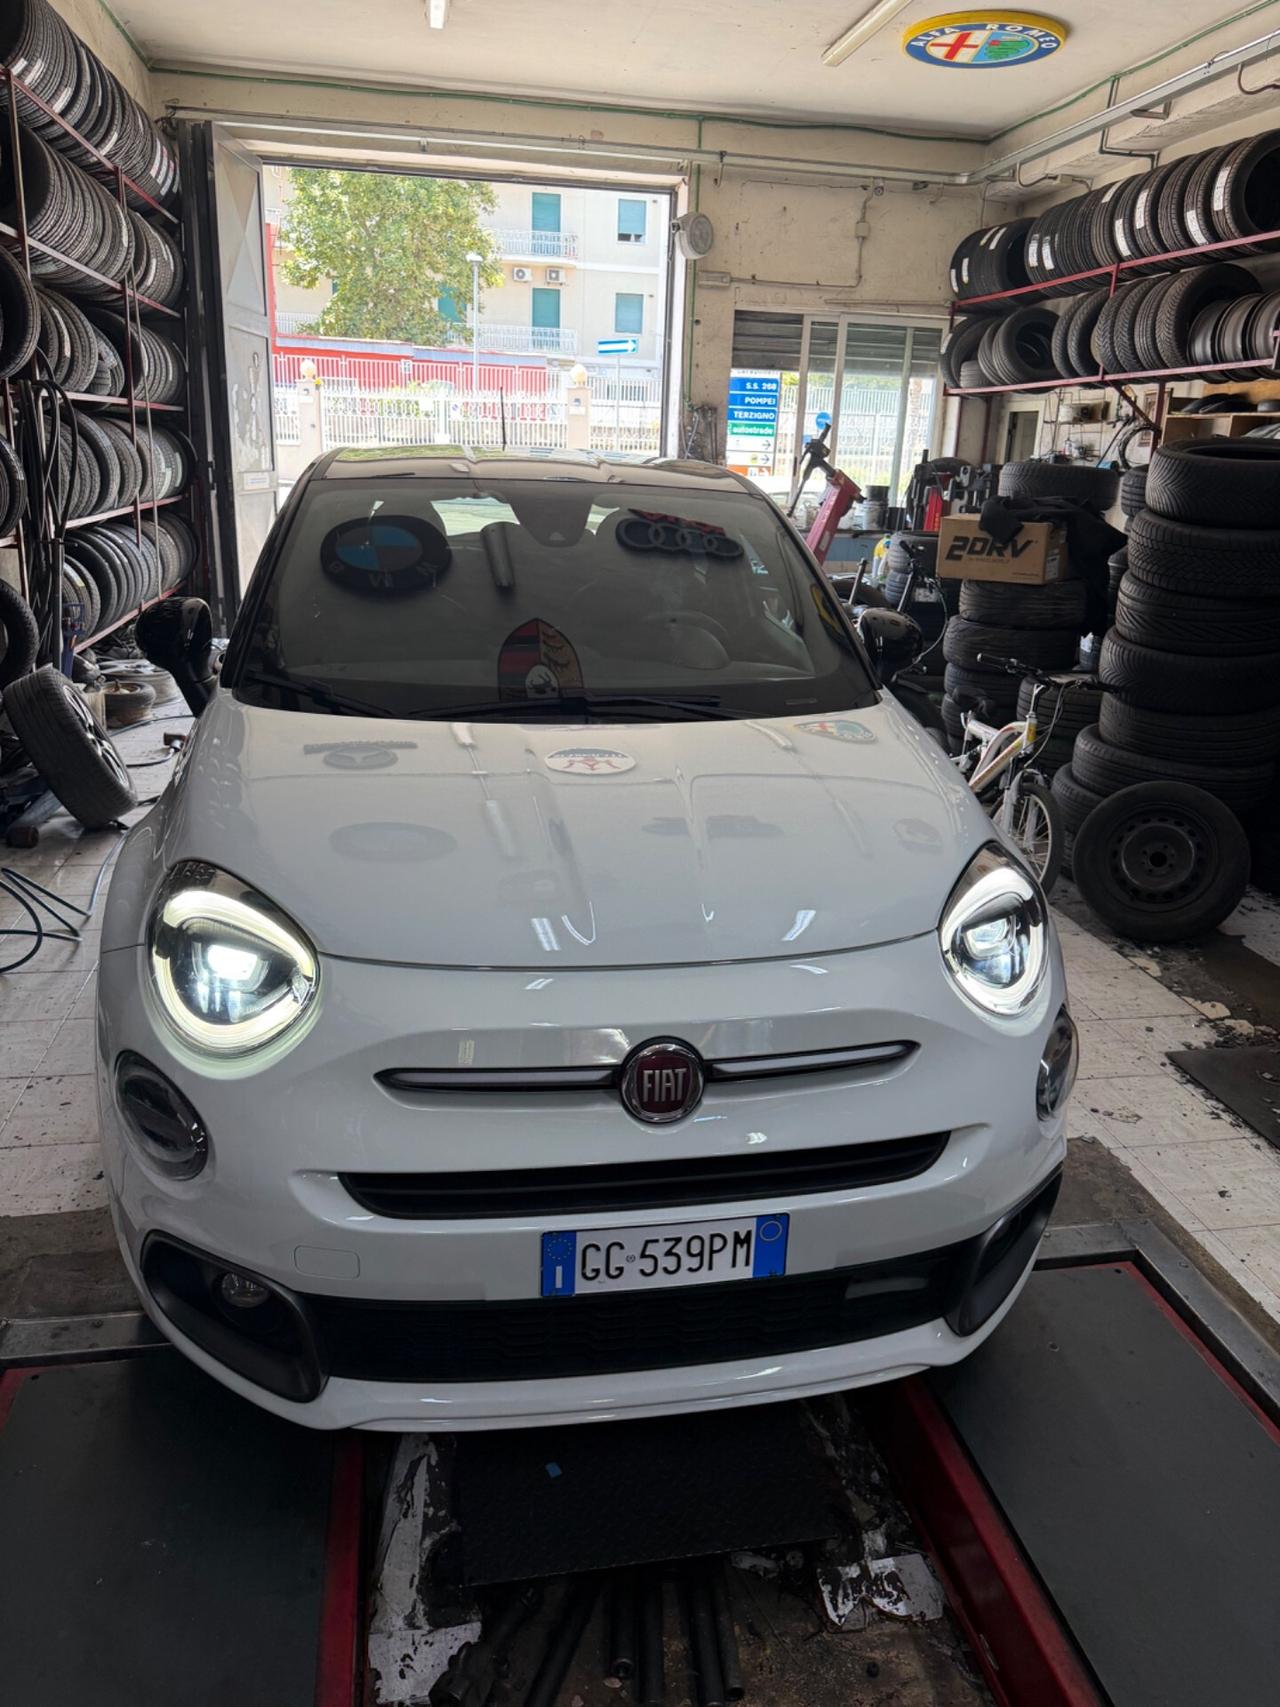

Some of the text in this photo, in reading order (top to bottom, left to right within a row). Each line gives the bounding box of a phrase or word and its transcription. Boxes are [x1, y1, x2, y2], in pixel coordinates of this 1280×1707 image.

[910, 23, 1057, 49] ALFA ROMEO
[745, 397, 776, 405] POMPEI
[734, 410, 775, 420] TERZIGNO
[643, 1067, 687, 1102] FIAT
[555, 1230, 752, 1289] I GG 539PM
